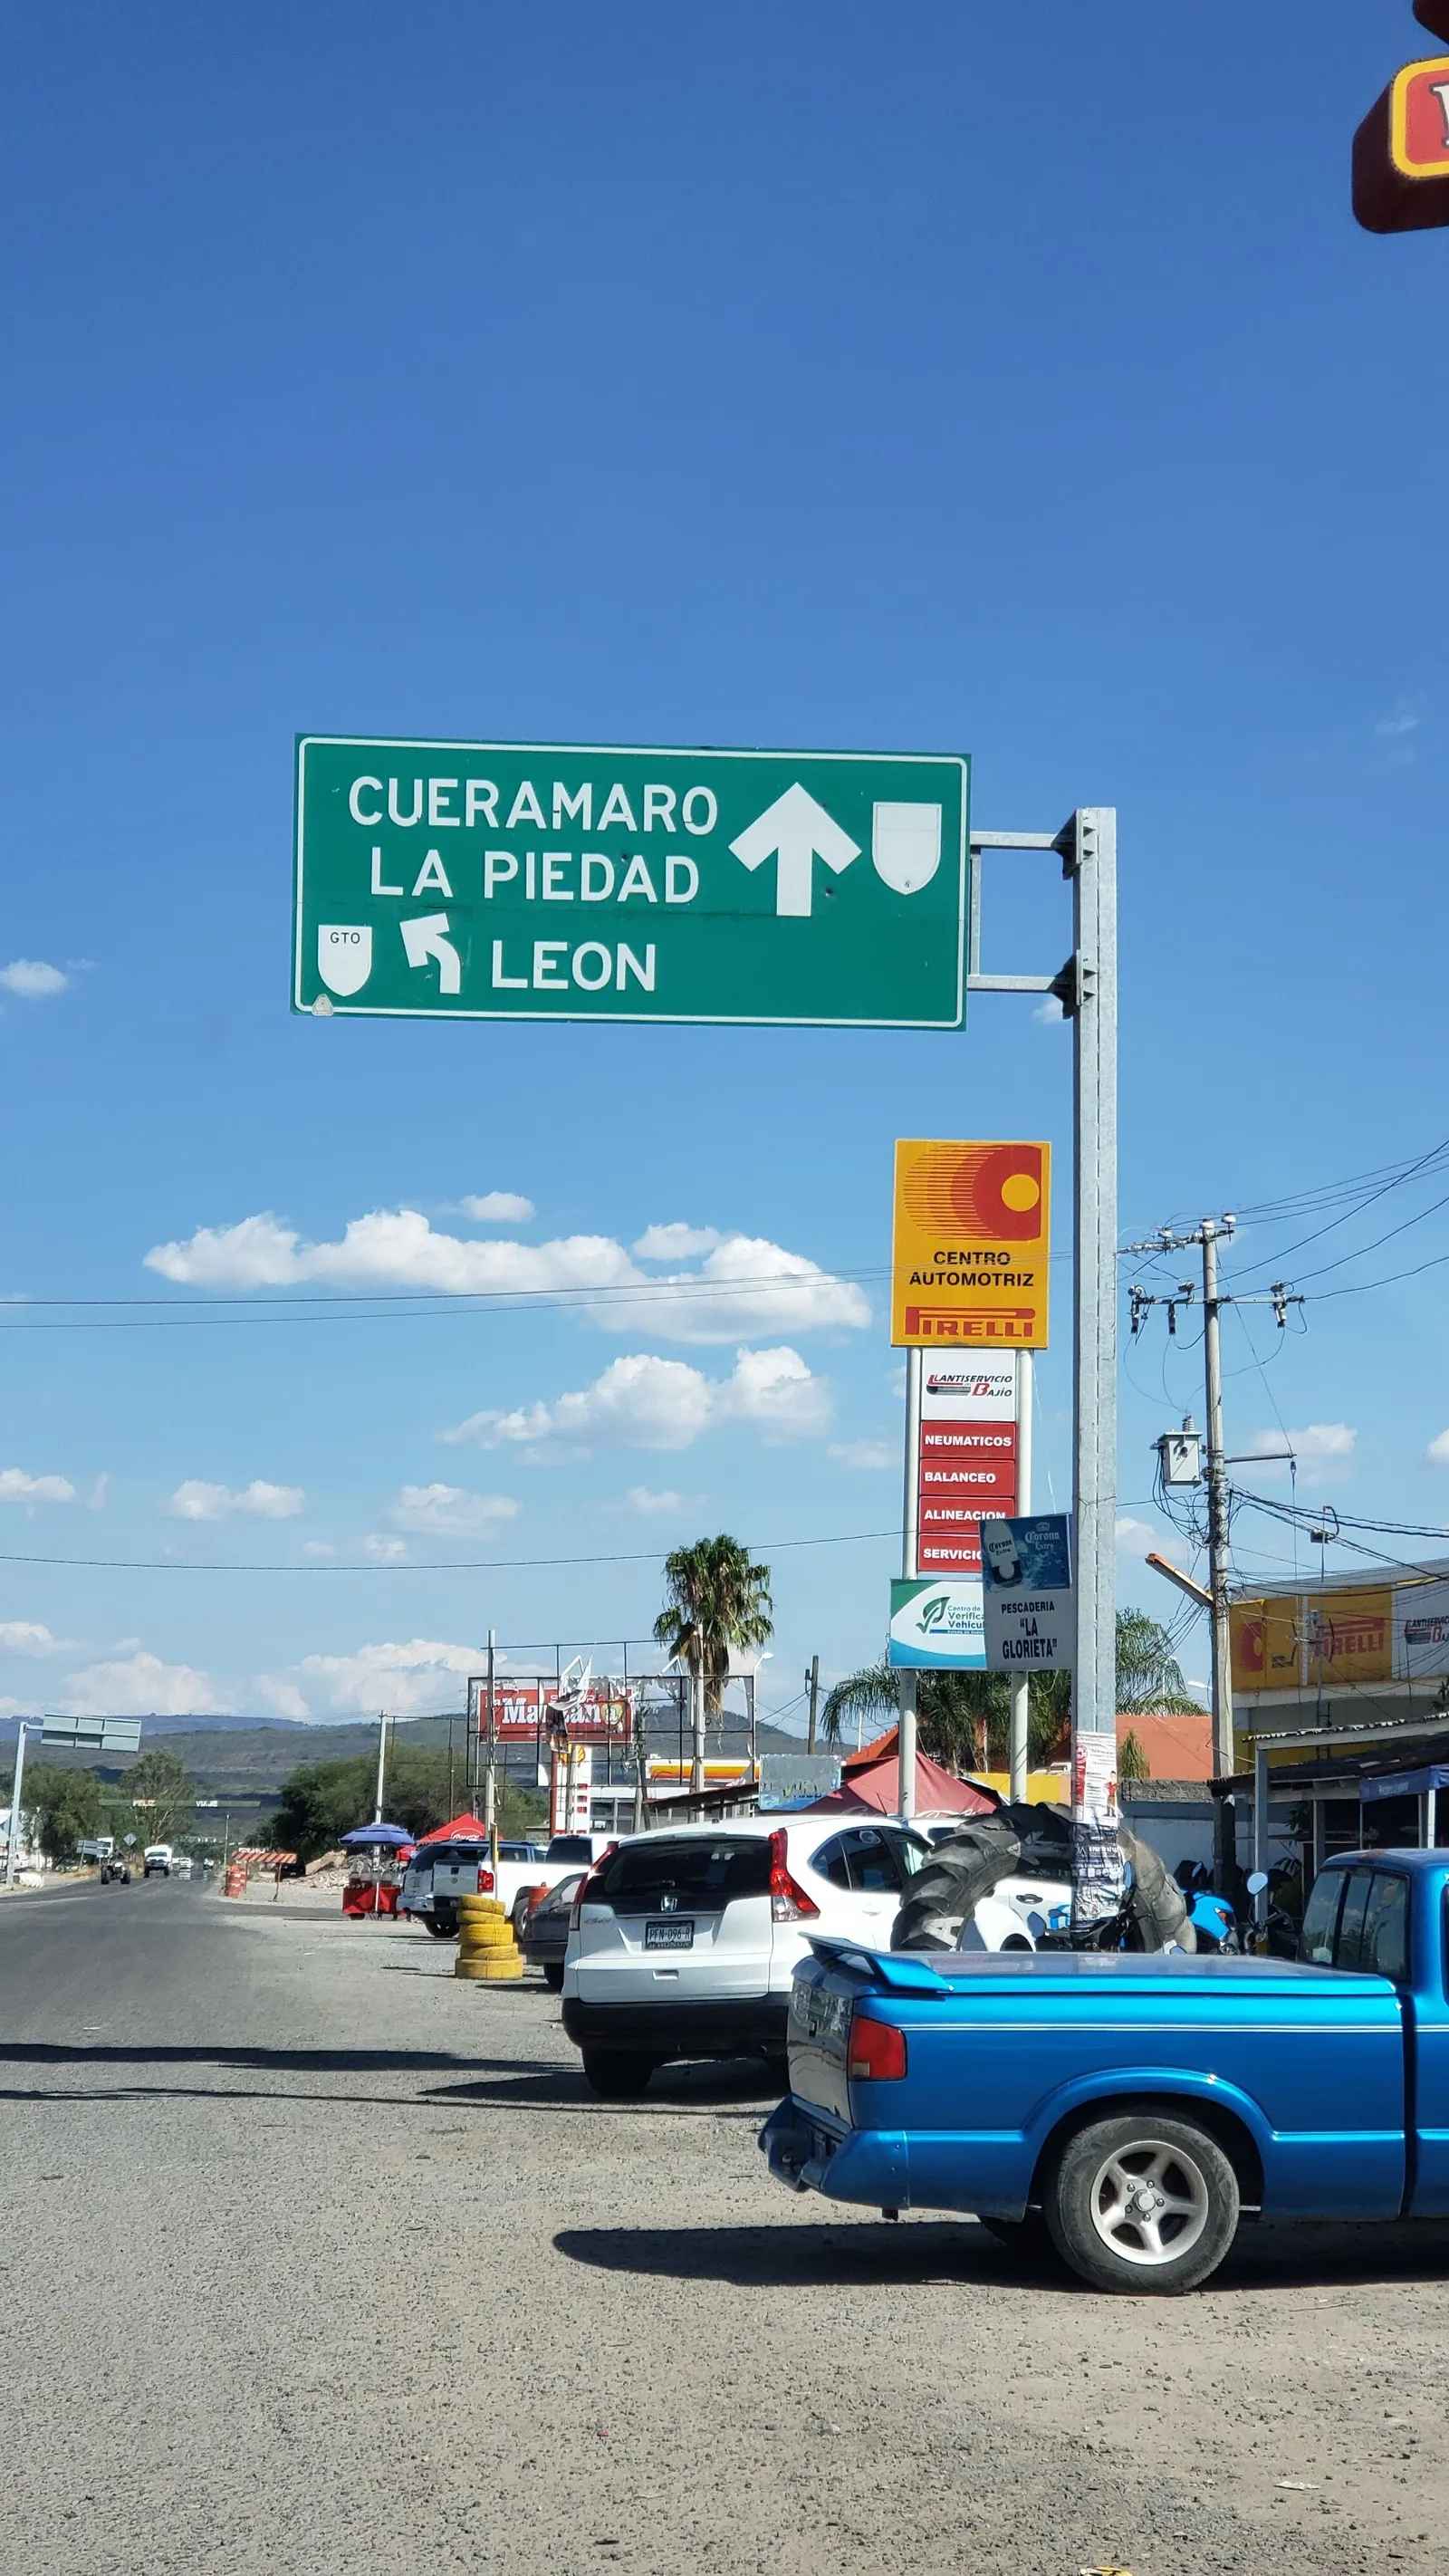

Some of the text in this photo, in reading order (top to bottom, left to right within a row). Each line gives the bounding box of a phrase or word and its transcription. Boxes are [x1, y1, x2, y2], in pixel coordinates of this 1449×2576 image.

[349, 775, 718, 835] CUERAMARO
[370, 847, 700, 903] LA PIEDAD
[330, 931, 360, 944] GTO
[492, 940, 656, 992] LEON
[934, 1252, 1011, 1265] CENTRO
[909, 1272, 1034, 1286] AUTOMOTRIZ
[905, 1306, 1036, 1337] PIRELLI
[928, 1375, 1012, 1385] LLANTISERVICIO
[925, 1436, 1012, 1447] NEUMATICOS
[925, 1472, 996, 1483] BALANCEO
[924, 1510, 1006, 1521] ALINEACION
[1025, 1532, 1060, 1543] Corona
[989, 1540, 1012, 1552] Corona
[1001, 1600, 1055, 1614] PESCADERIA
